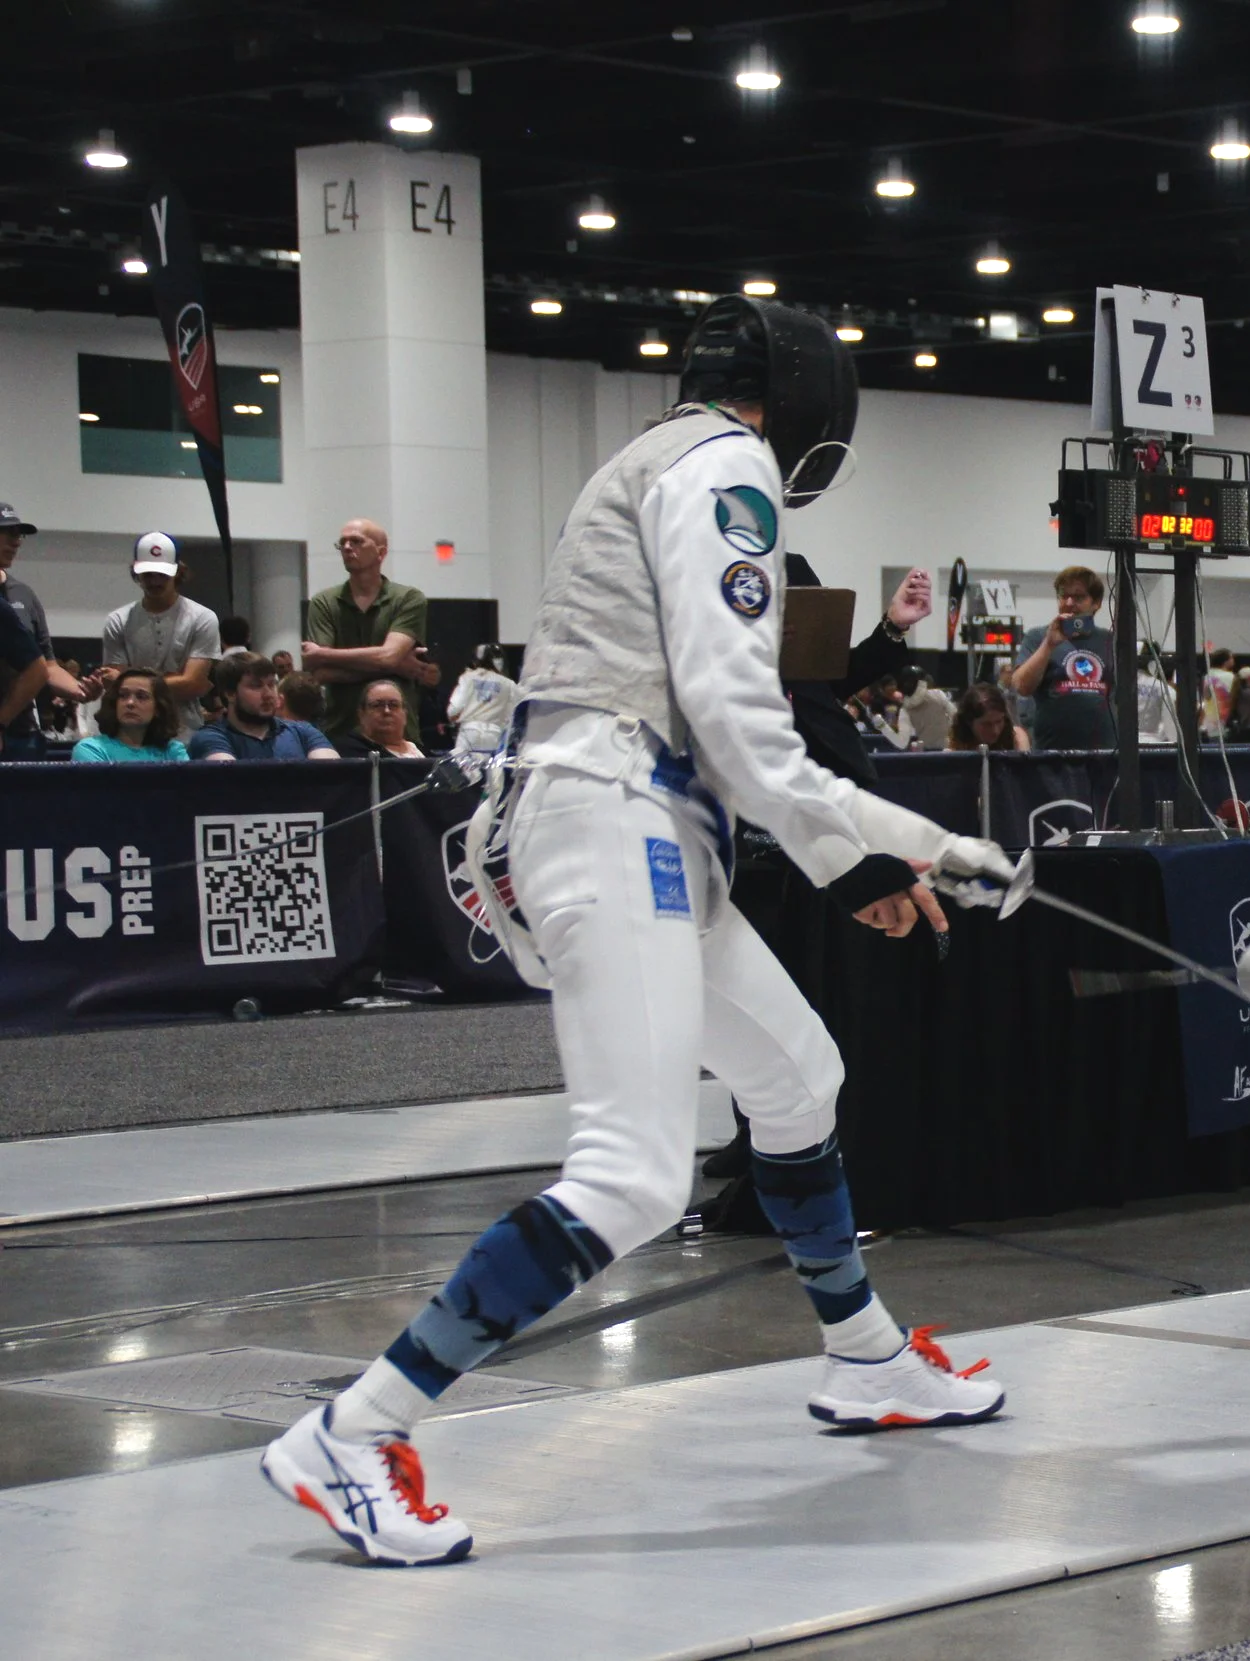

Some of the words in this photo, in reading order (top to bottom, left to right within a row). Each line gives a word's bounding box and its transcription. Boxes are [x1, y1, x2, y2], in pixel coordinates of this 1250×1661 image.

[150, 195, 168, 267] Y
[323, 178, 360, 235] E4
[410, 180, 456, 236] E4
[1132, 319, 1173, 407] Z
[1181, 325, 1196, 358] 3
[150, 545, 163, 558] C
[1194, 518, 1214, 541] 00
[986, 587, 999, 609] Y
[5, 846, 114, 942] US
[119, 845, 155, 937] PREP
